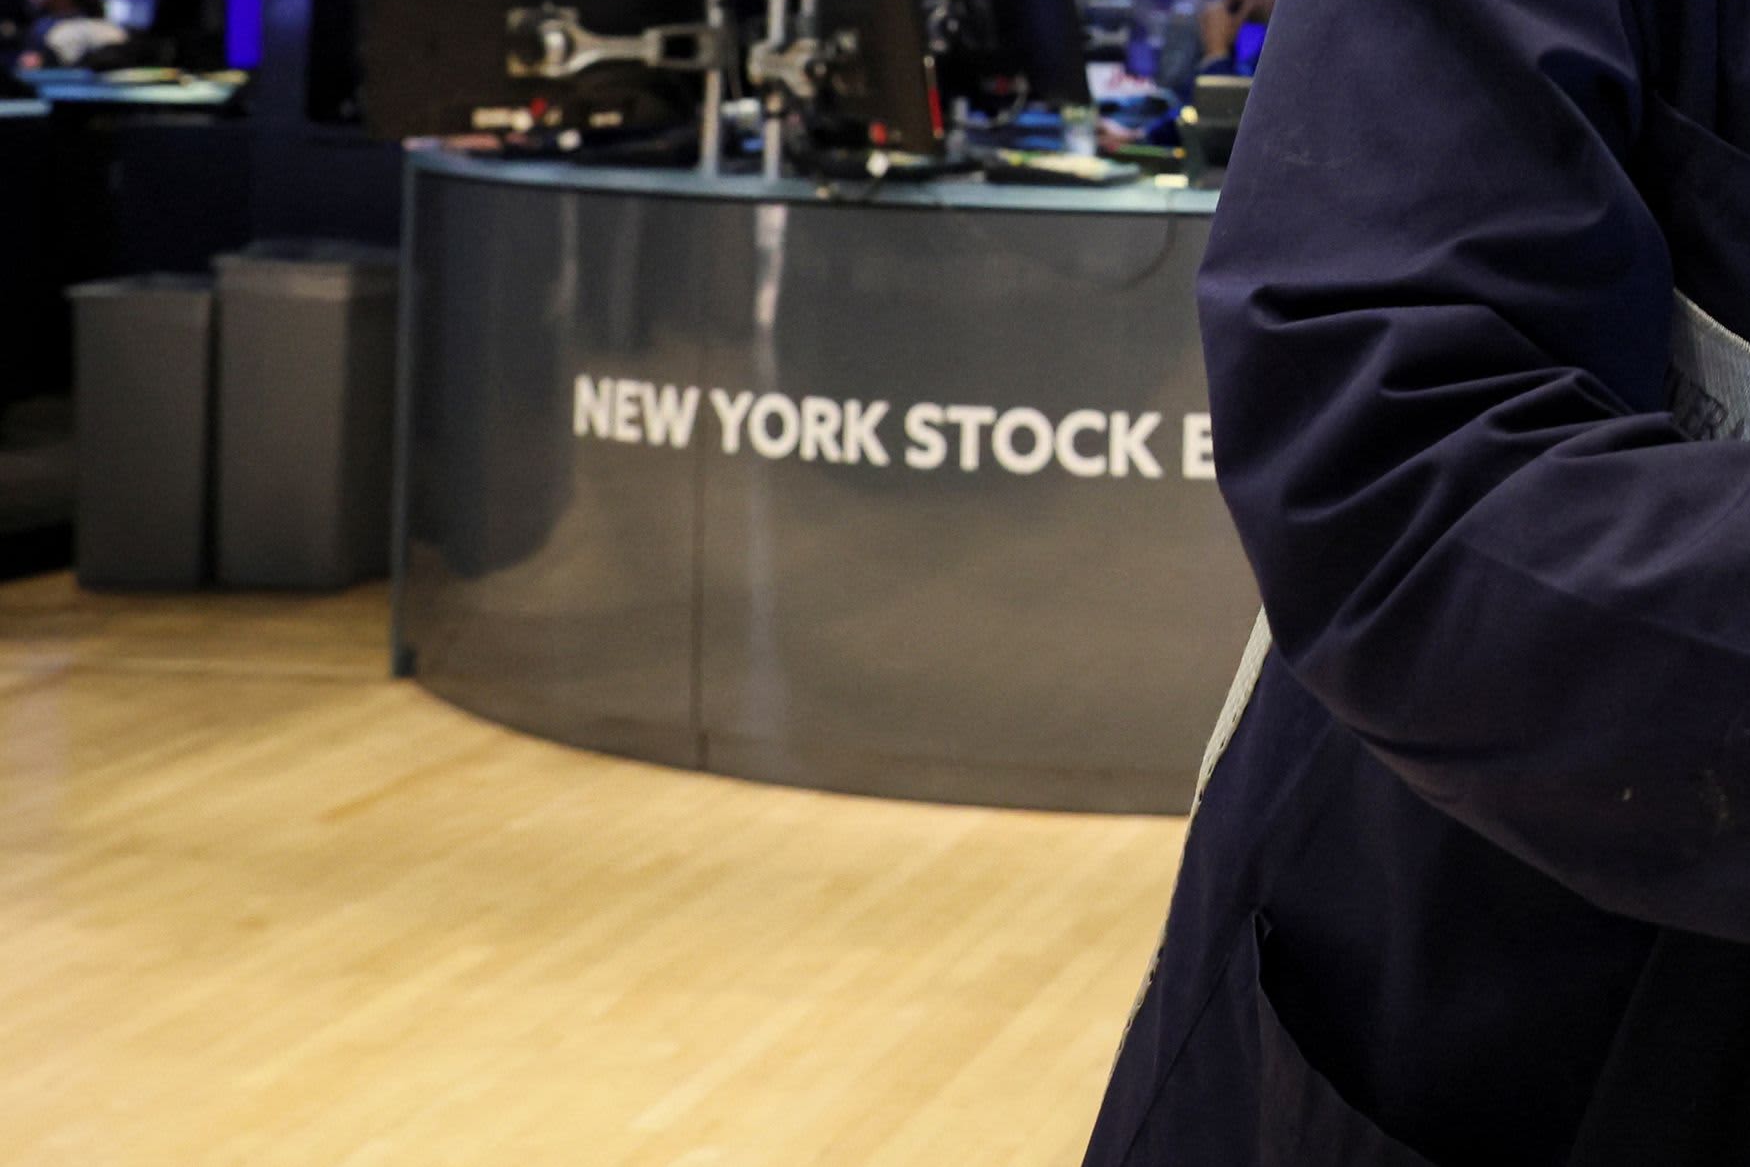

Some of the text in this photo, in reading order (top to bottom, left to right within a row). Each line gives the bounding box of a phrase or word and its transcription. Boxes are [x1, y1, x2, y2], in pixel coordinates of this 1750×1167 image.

[573, 374, 701, 449] NEW
[709, 388, 892, 467] YORK
[903, 401, 1164, 479] STOCK
